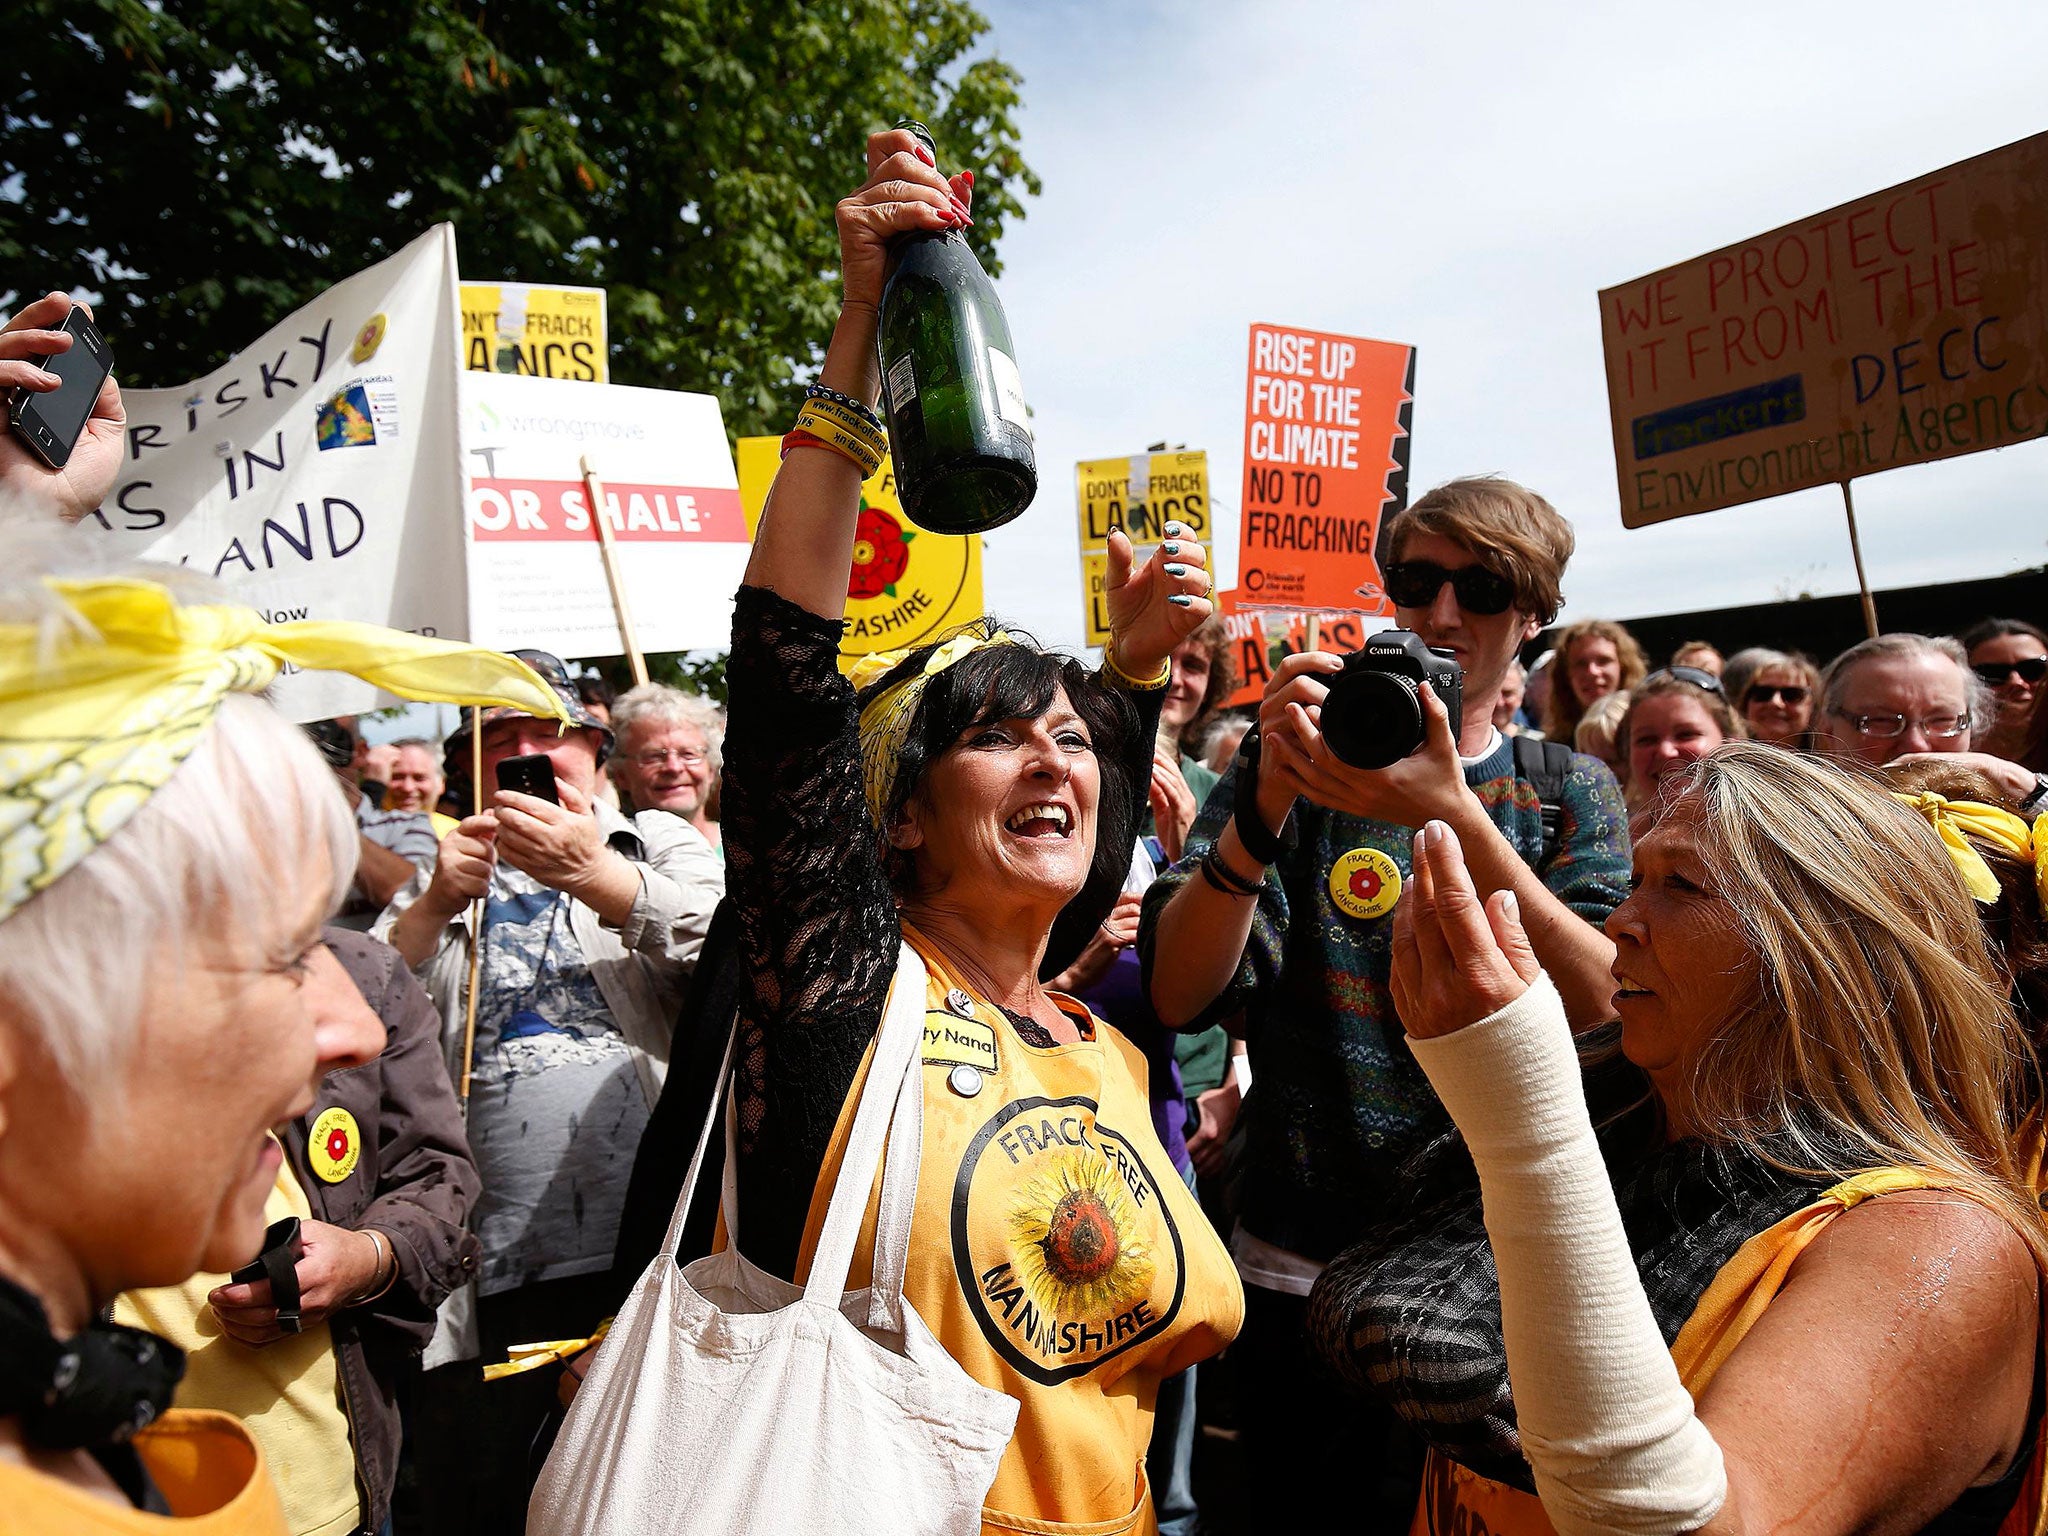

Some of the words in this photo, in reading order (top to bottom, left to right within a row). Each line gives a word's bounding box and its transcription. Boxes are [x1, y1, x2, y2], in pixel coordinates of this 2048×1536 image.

[1616, 275, 1682, 335] WE
[1708, 181, 1948, 312] PROTECT
[526, 312, 593, 337] FRACK
[1627, 338, 1668, 399] IT
[1688, 288, 1836, 380] FROM
[1861, 241, 1985, 328] THE
[1253, 330, 1315, 378] RISE
[1319, 343, 1357, 382] UP
[1850, 315, 2008, 405] DECC
[1251, 375, 1305, 421] FOR
[1310, 383, 1362, 428] THE
[508, 414, 645, 441] wrongmove
[1249, 420, 1361, 470] CLIMATE
[1086, 479, 1132, 499] DON'T
[1149, 473, 1201, 495] FRACK
[1249, 467, 1284, 504] NO
[1295, 472, 1323, 508] TO
[1634, 422, 1875, 512] Environment
[560, 489, 703, 533] SHALE
[1088, 495, 1204, 540] LANCS
[1246, 511, 1371, 555] FRACKING
[1369, 646, 1403, 656] Canon
[1439, 673, 1453, 681] EOS
[1346, 854, 1376, 865] FRACK
[1379, 861, 1397, 880] FREE
[1336, 888, 1384, 914] LANCASHIRE
[945, 1027, 992, 1054] Nana
[997, 1116, 1097, 1165] FRACK
[1101, 1143, 1150, 1209] FREE
[982, 1261, 1158, 1358] NANNASHIRE
